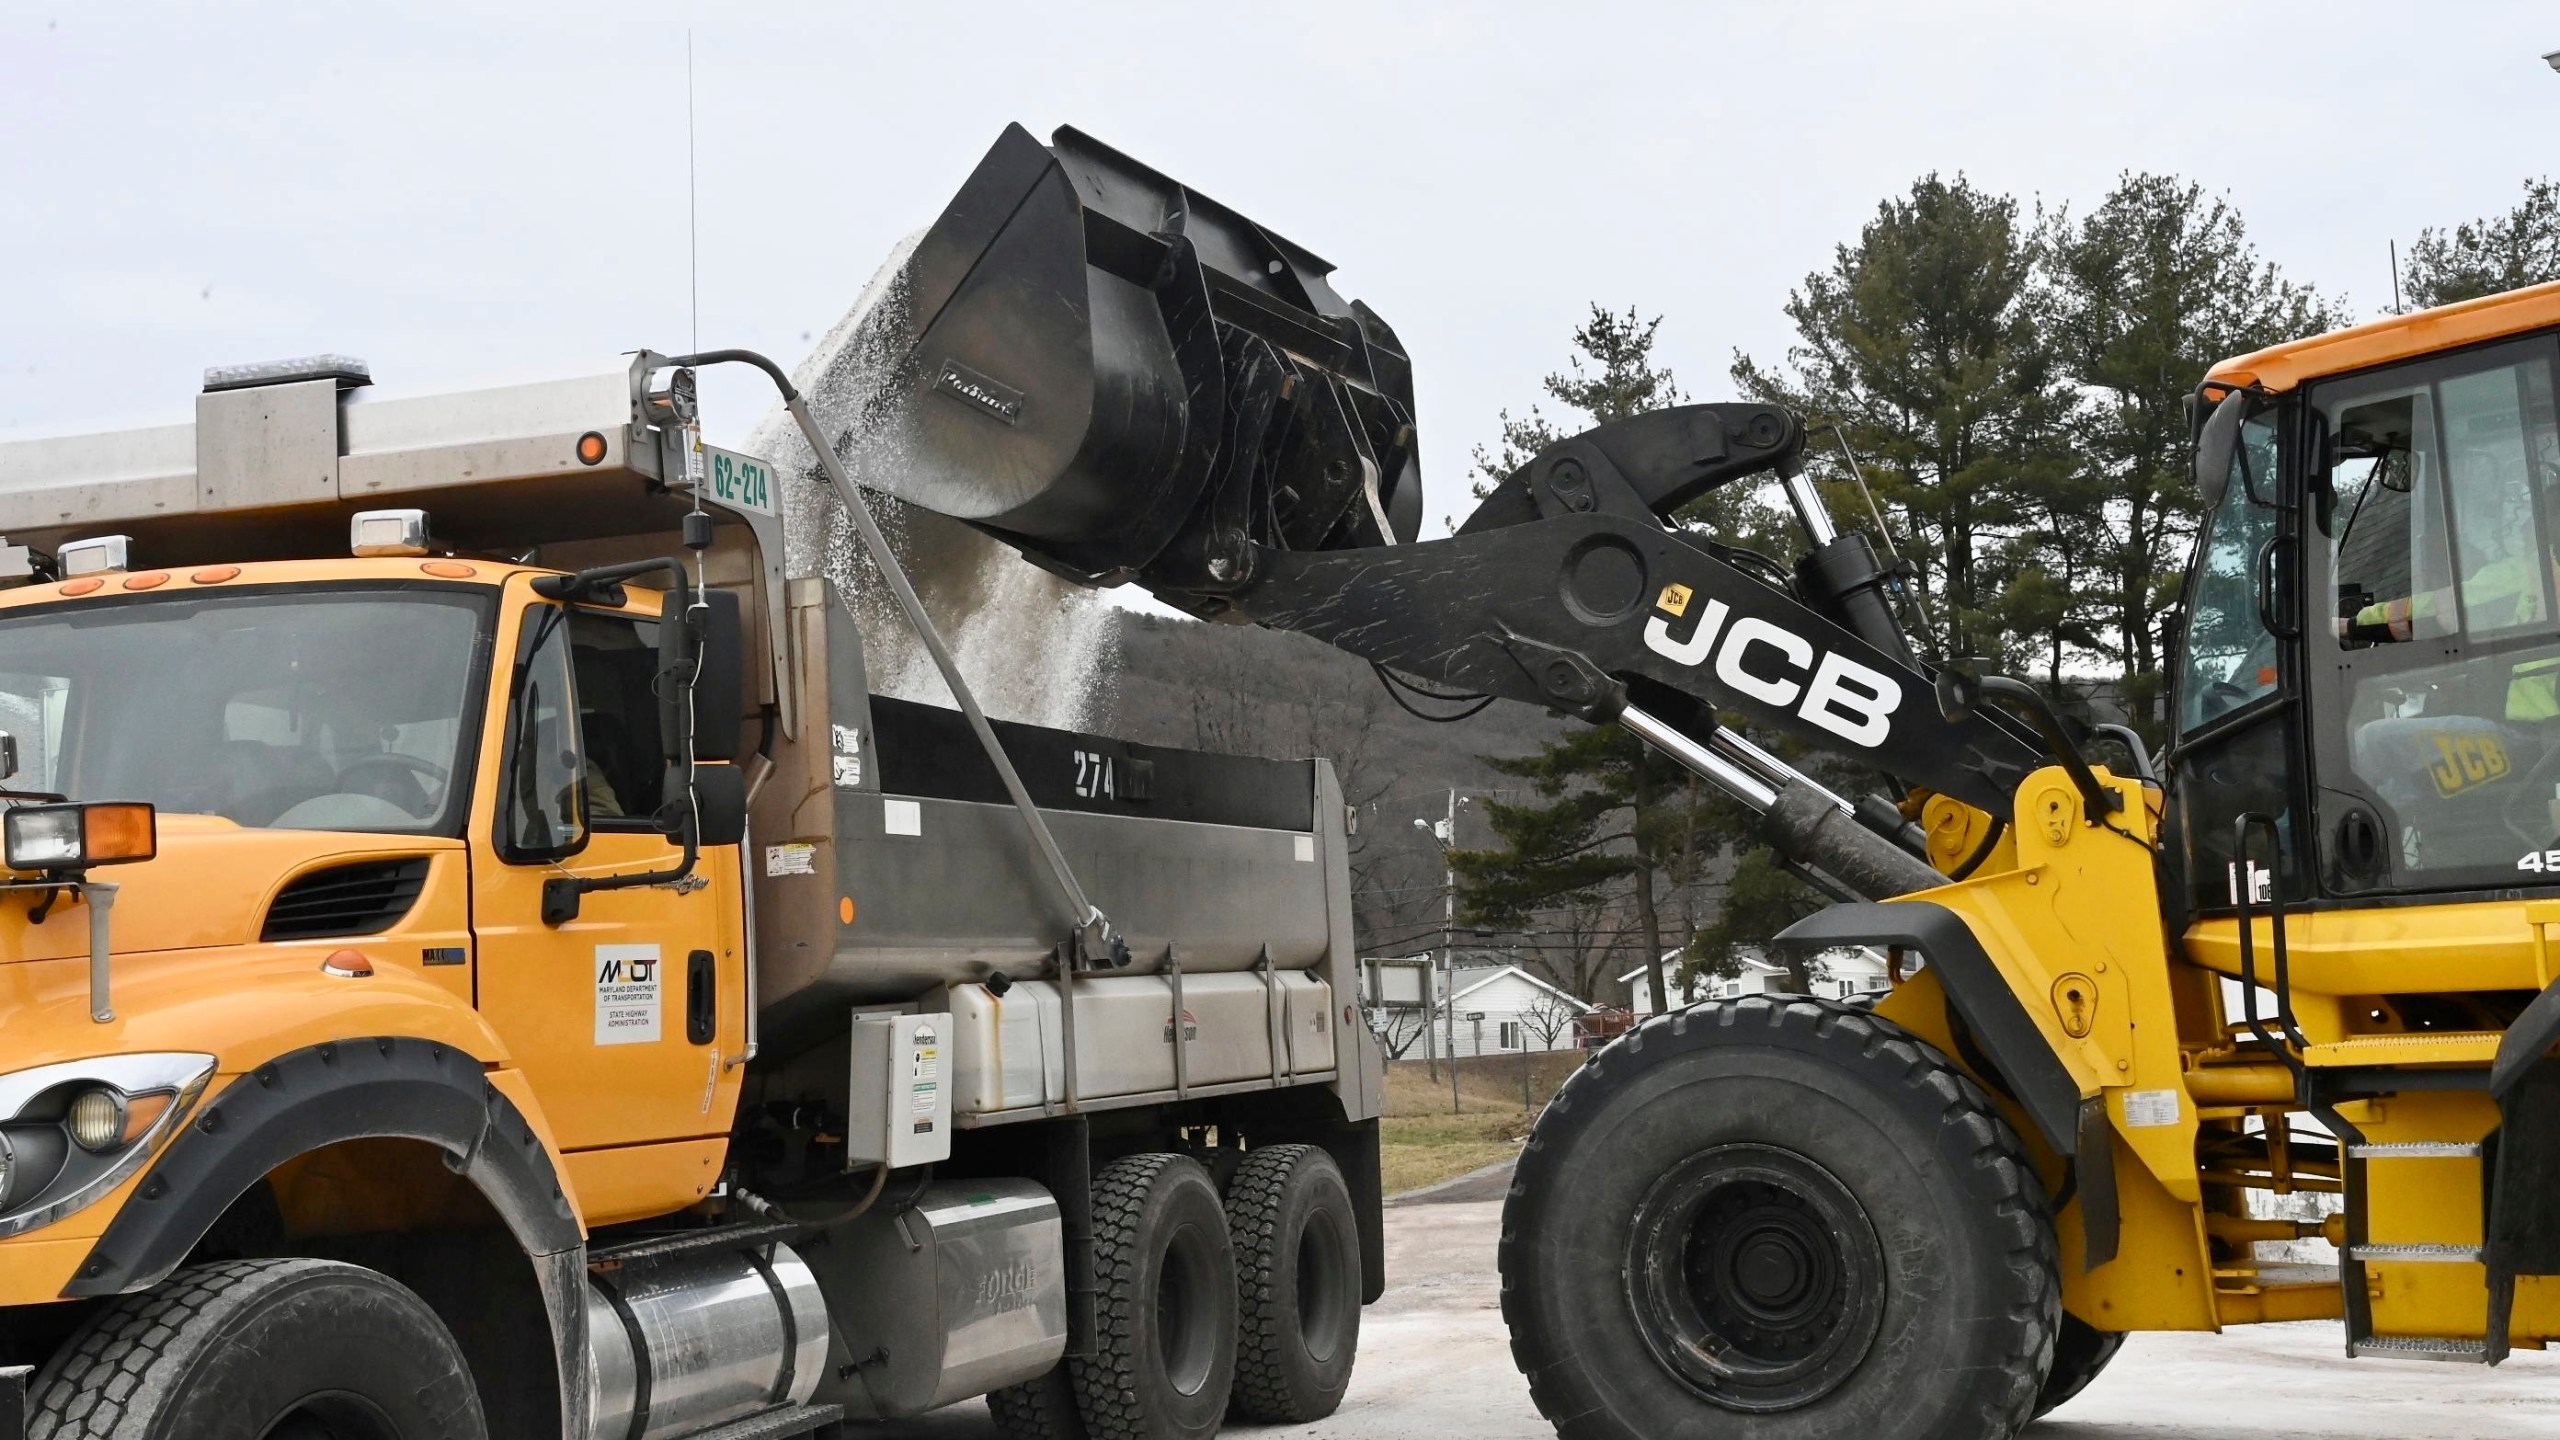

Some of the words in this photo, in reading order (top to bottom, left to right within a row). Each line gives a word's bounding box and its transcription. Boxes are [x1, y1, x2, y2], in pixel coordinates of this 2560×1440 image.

[714, 453, 768, 509] 62-274
[1667, 589, 1683, 604] JCB
[1644, 598, 1902, 748] JCB
[1074, 750, 1114, 801] 274
[2433, 736, 2505, 790] JCB
[598, 960, 657, 983] MDOT
[608, 1019, 649, 1027] ADMINISTRATION
